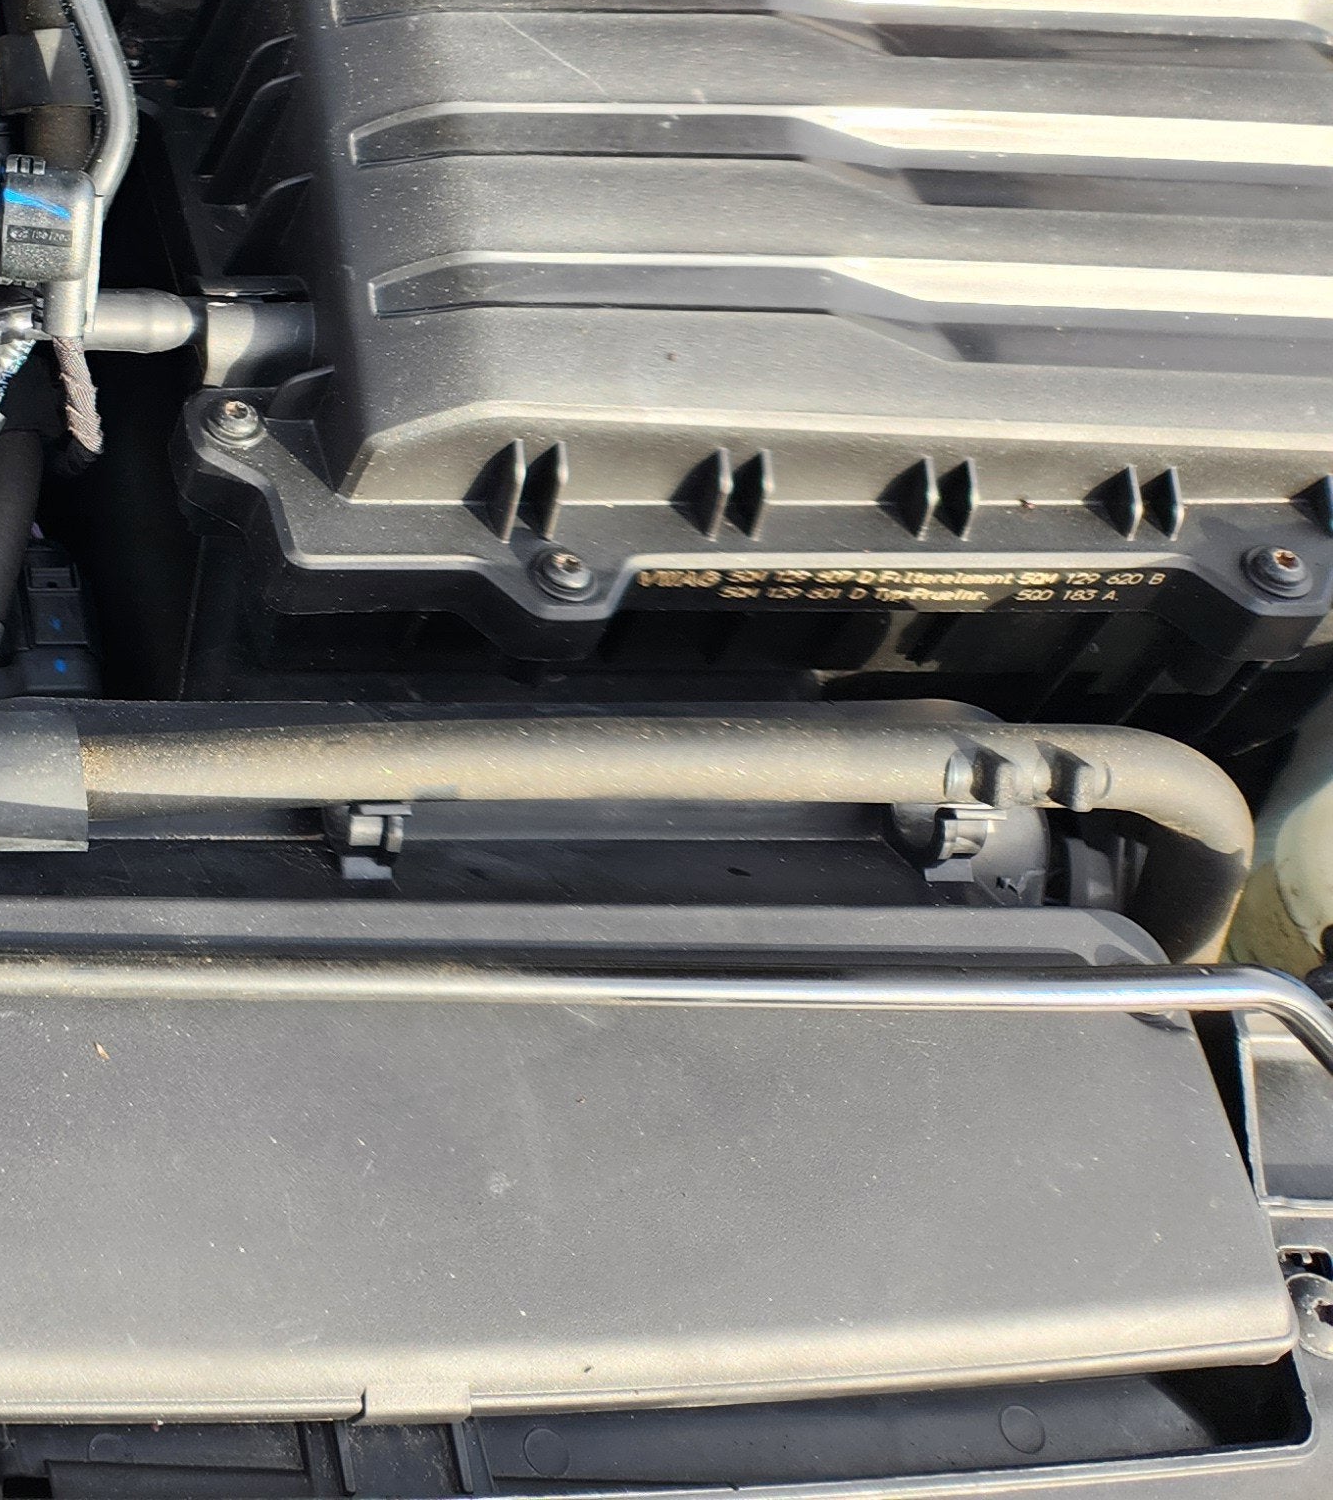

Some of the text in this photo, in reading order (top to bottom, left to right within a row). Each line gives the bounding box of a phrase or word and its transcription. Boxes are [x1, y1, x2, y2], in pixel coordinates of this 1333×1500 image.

[1065, 572, 1101, 586] 129
[1105, 572, 1145, 586] 620
[1147, 572, 1168, 586] B
[1062, 588, 1097, 601] 183
